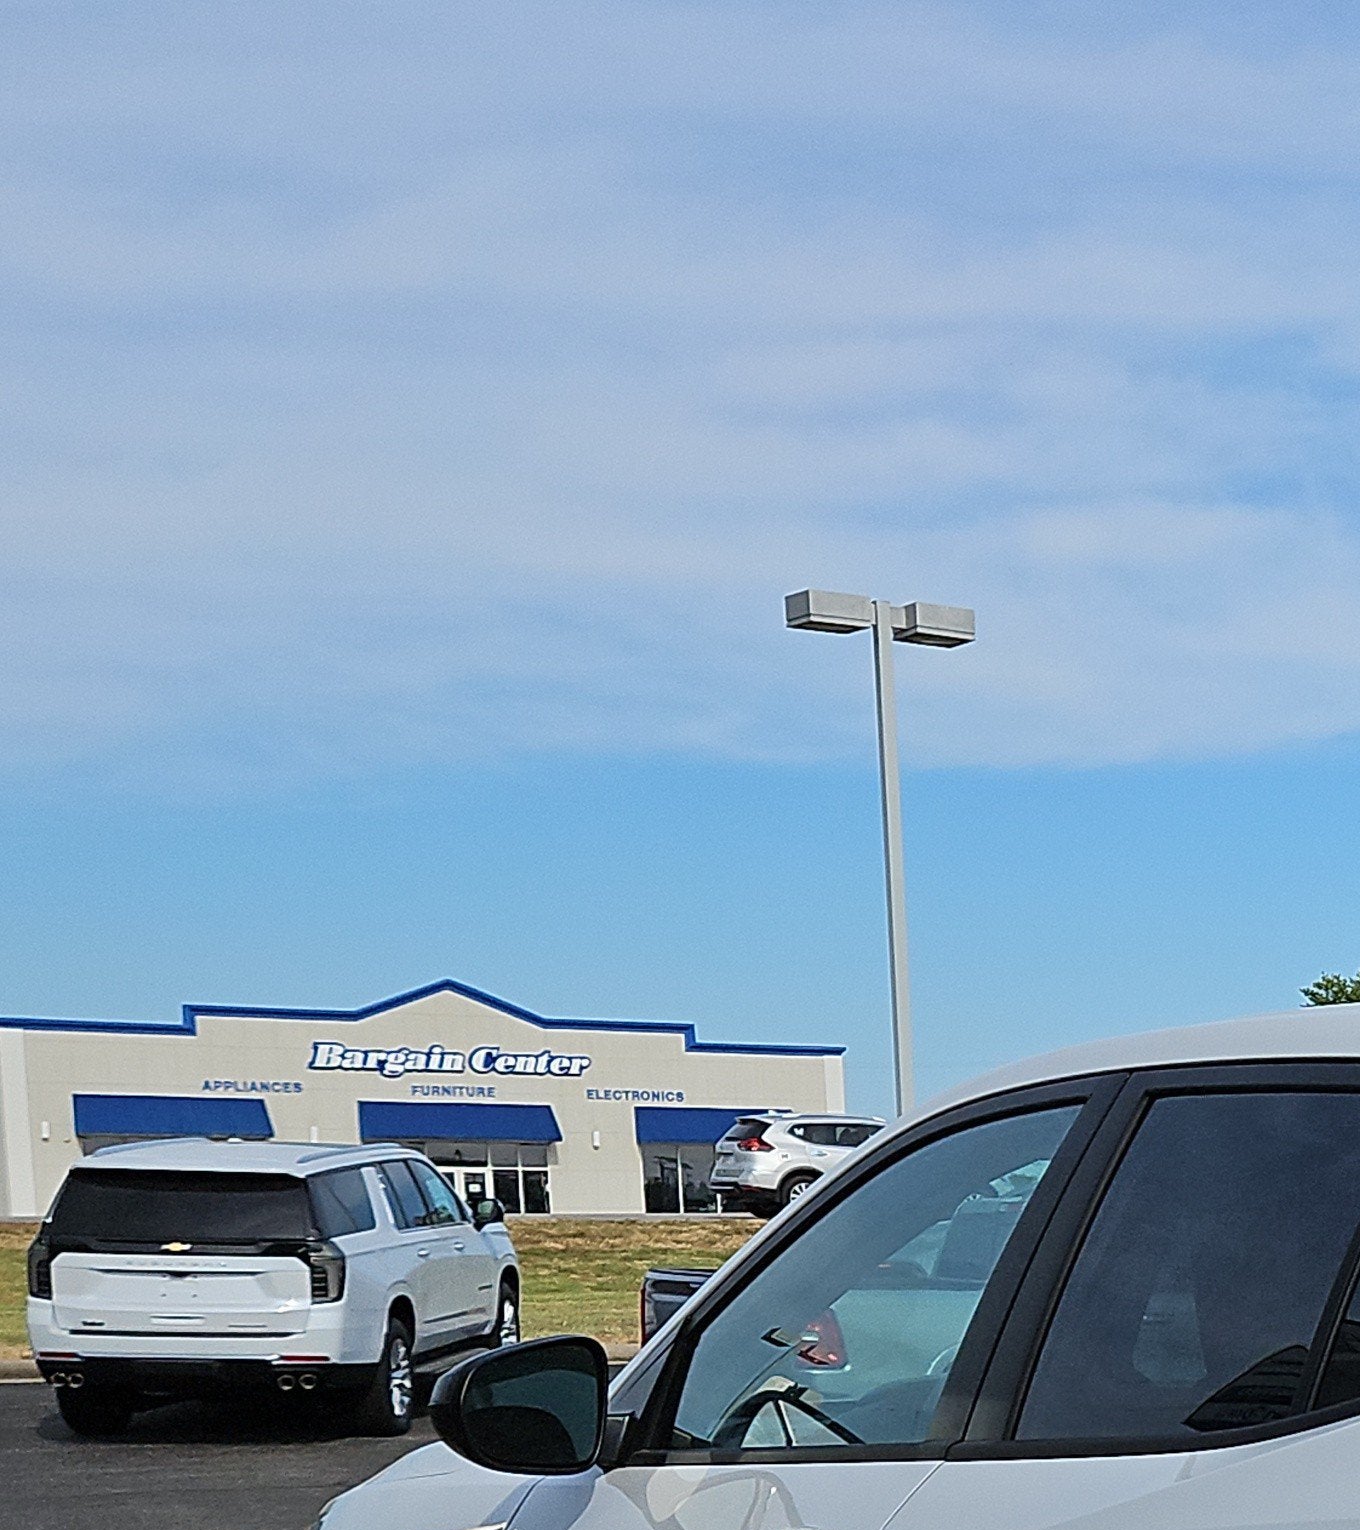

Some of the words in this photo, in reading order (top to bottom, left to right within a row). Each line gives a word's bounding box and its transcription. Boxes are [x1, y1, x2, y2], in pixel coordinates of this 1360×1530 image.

[308, 1042, 465, 1078] Bargain
[469, 1046, 591, 1077] Center
[202, 1080, 303, 1093] APPLIANCES
[410, 1084, 496, 1098] FURNITURE
[586, 1088, 685, 1103] ELECTRONICS
